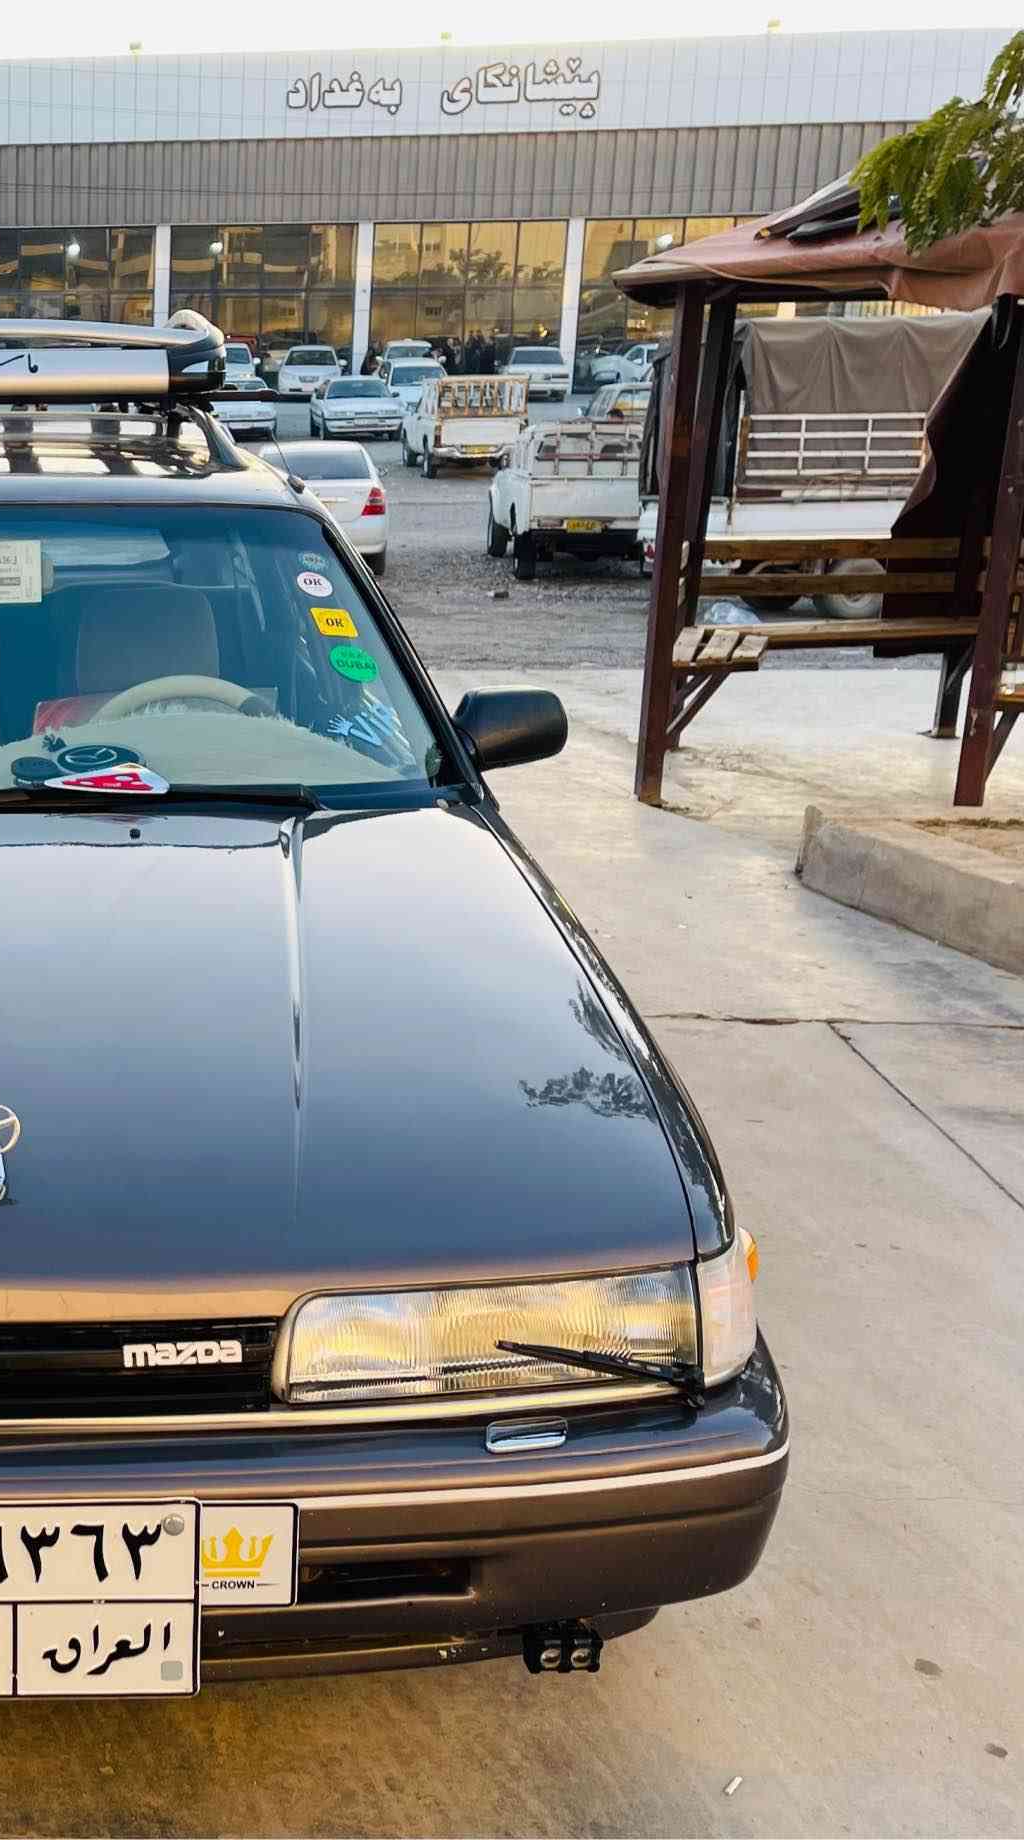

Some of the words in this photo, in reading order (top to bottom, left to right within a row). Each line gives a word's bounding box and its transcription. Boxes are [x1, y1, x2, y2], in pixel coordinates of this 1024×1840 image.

[303, 578, 323, 586] OK
[325, 617, 345, 628] OK
[211, 1580, 255, 1590] CROWN
[42, 1620, 173, 1677] العراق
